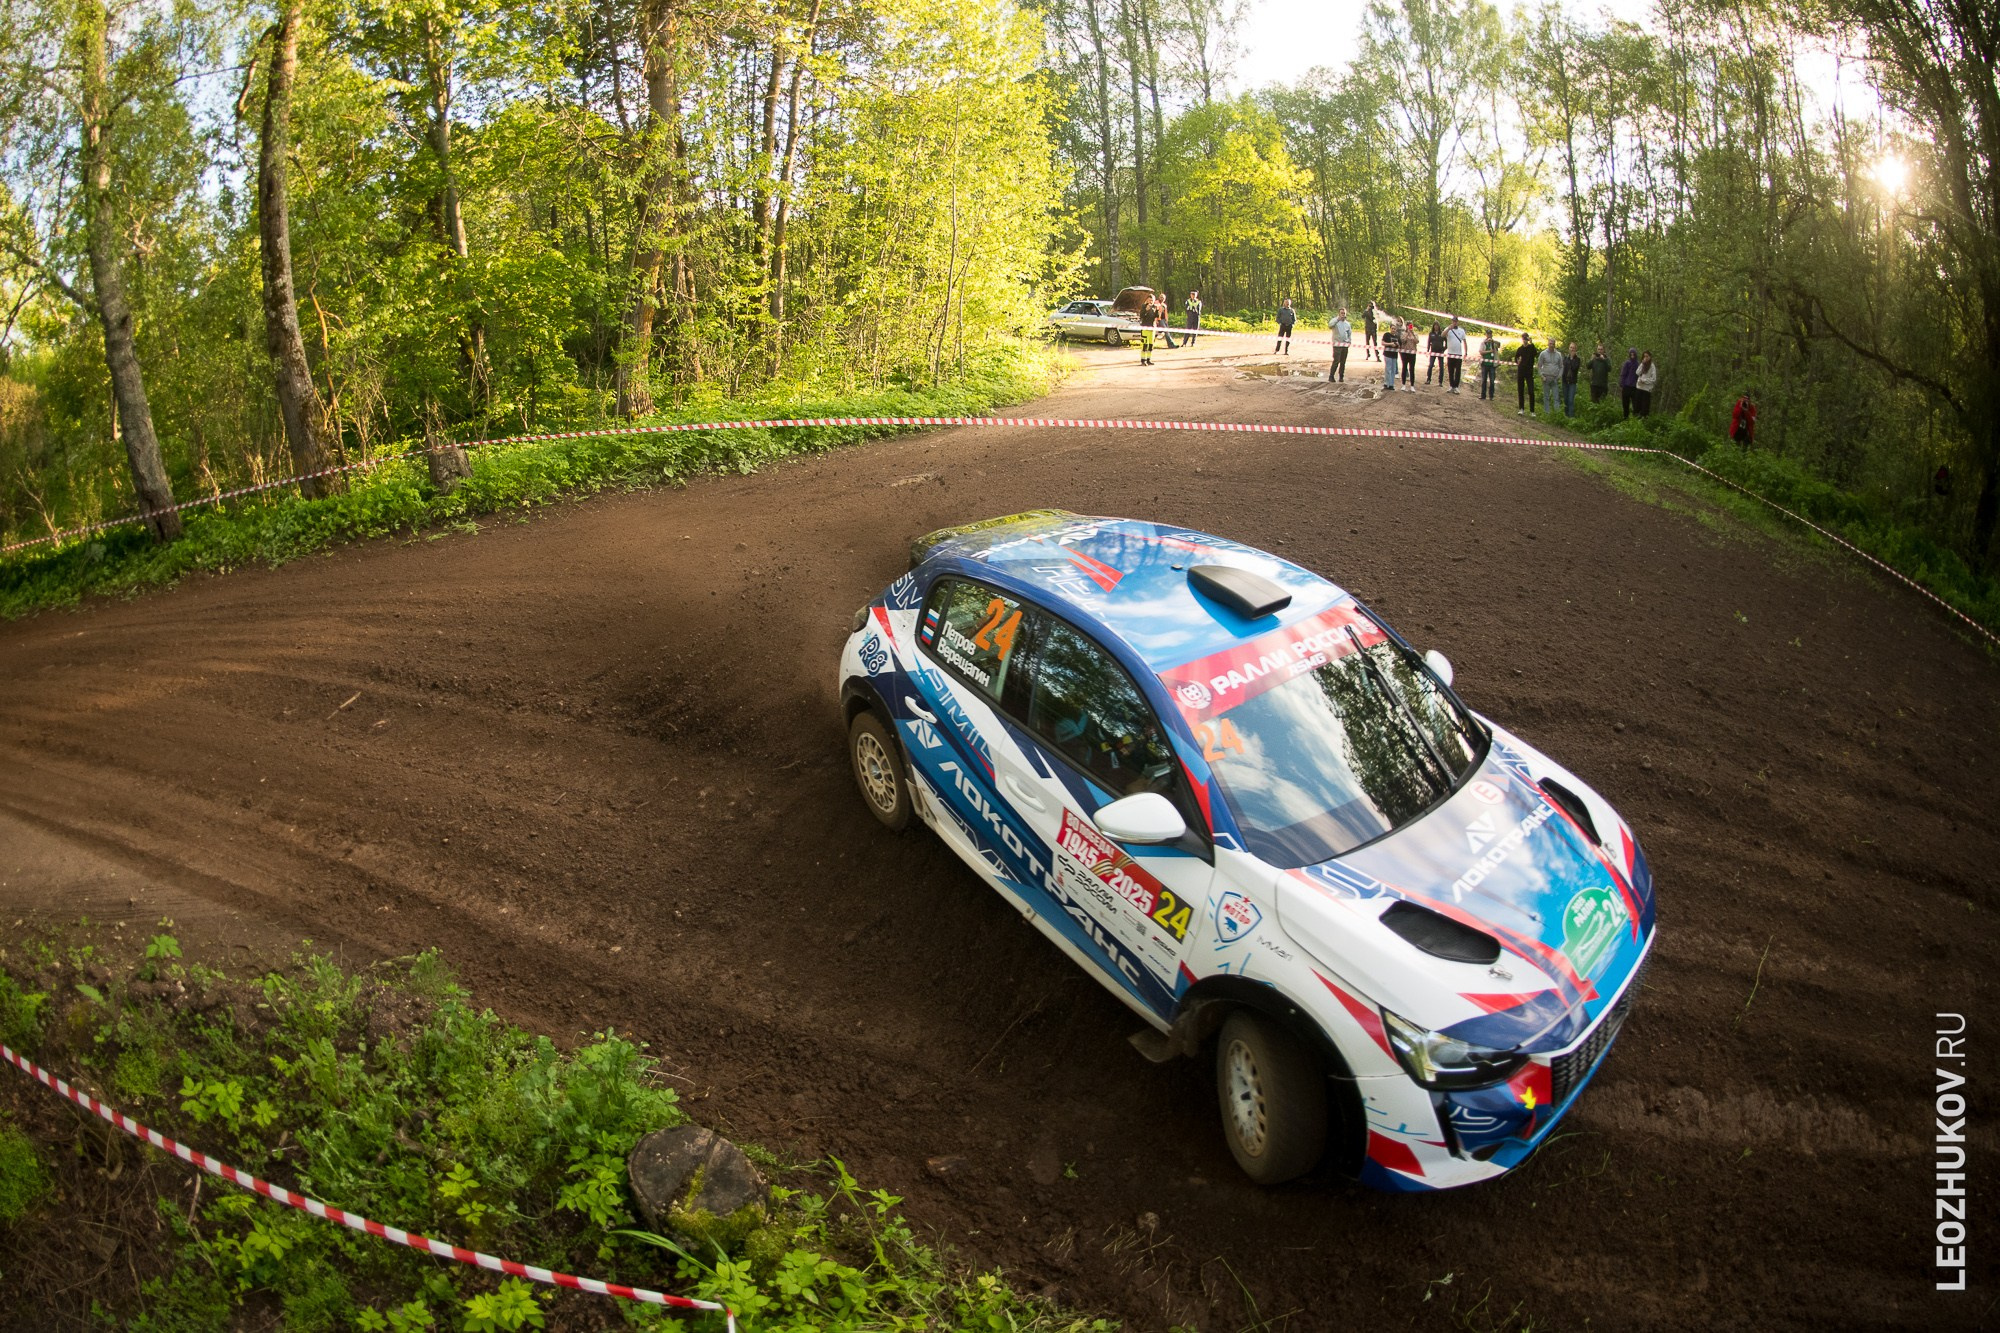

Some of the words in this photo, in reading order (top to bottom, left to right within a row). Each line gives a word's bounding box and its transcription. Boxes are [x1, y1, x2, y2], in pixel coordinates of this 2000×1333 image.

[942, 620, 977, 656] Петров
[974, 598, 1023, 661] 24
[936, 636, 991, 688] Верещагин
[1210, 650, 1289, 696] РАЛЛИ
[1193, 717, 1244, 763] 24
[938, 760, 1141, 987] ЛОКОТРАНС
[1061, 827, 1100, 870] 1945
[1108, 867, 1155, 915] 2025
[1452, 803, 1554, 904] ЛОКОТРАНС
[1153, 890, 1192, 940] 24
[1602, 891, 1626, 928] 24
